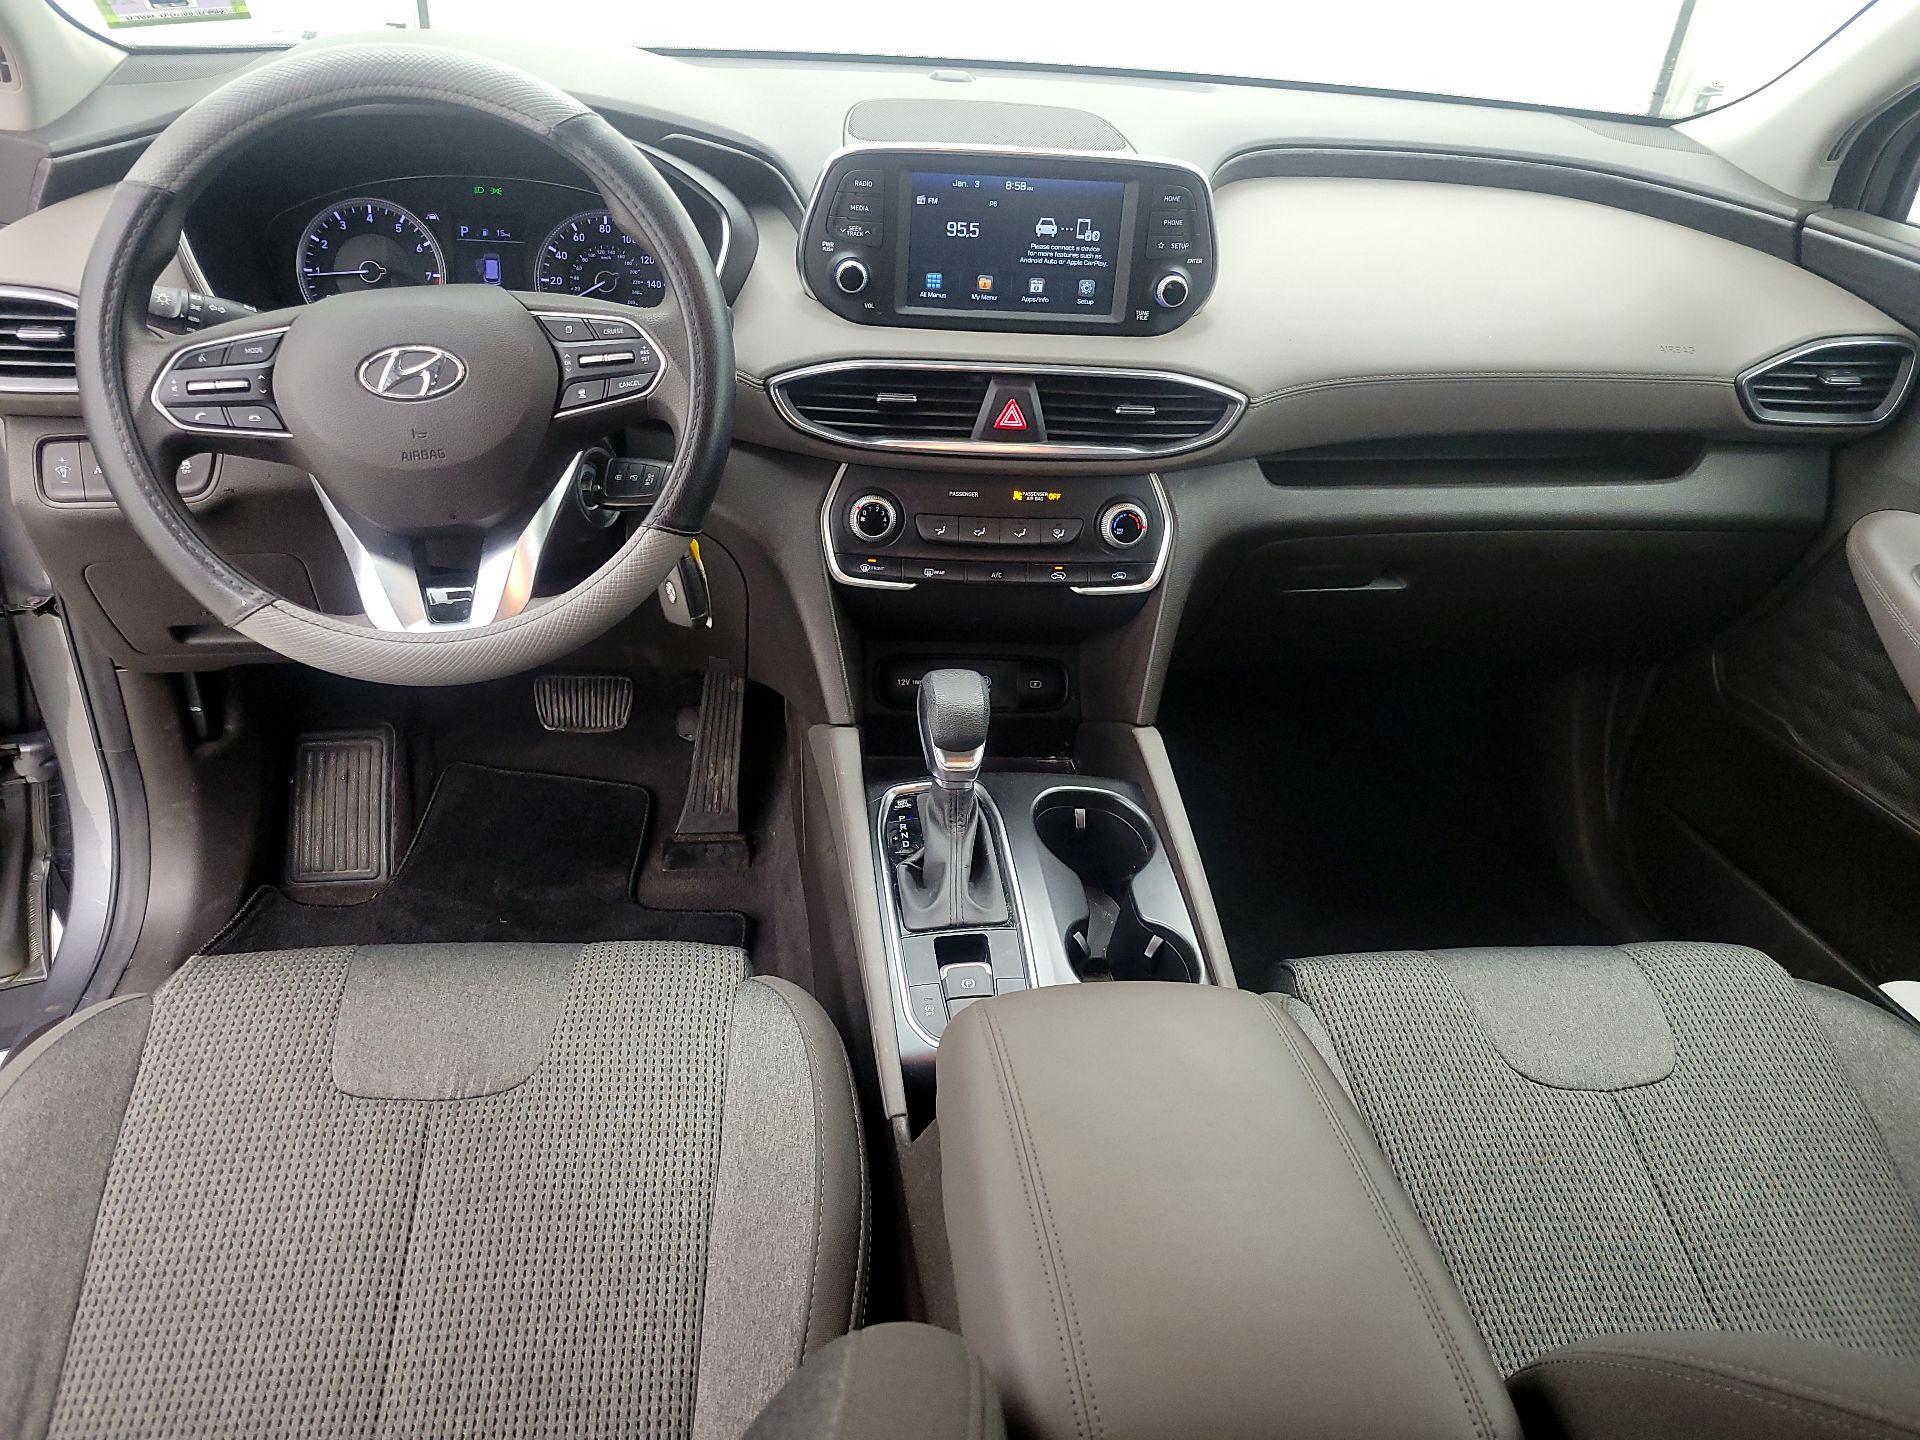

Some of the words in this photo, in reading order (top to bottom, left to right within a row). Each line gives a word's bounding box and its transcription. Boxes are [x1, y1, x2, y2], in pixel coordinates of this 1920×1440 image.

[854, 180, 873, 188] RADIO
[952, 180, 969, 188] Jan.
[974, 180, 980, 188] 3
[927, 197, 939, 205] FM
[850, 204, 869, 212] MEDIA
[366, 213, 374, 223] 4
[339, 220, 347, 230] 3
[395, 223, 402, 232] 5
[600, 224, 611, 233] 80
[946, 221, 980, 238] 95.5
[460, 225, 469, 237] P
[573, 233, 585, 242] 60
[321, 240, 328, 249] 2
[416, 244, 423, 253] 6
[555, 252, 567, 260] 40
[640, 256, 655, 265] 120
[1066, 259, 1083, 267] Apple
[1083, 260, 1108, 268] CarPlay.
[425, 272, 431, 280] 7
[551, 276, 562, 285] 20
[647, 280, 661, 289] 140
[1076, 298, 1094, 306] Setup
[603, 327, 624, 335] CRUISE
[244, 346, 263, 354] MODE
[619, 380, 641, 388] CANCEL
[401, 449, 446, 462] AIRBAG
[1048, 492, 1061, 500] OFF
